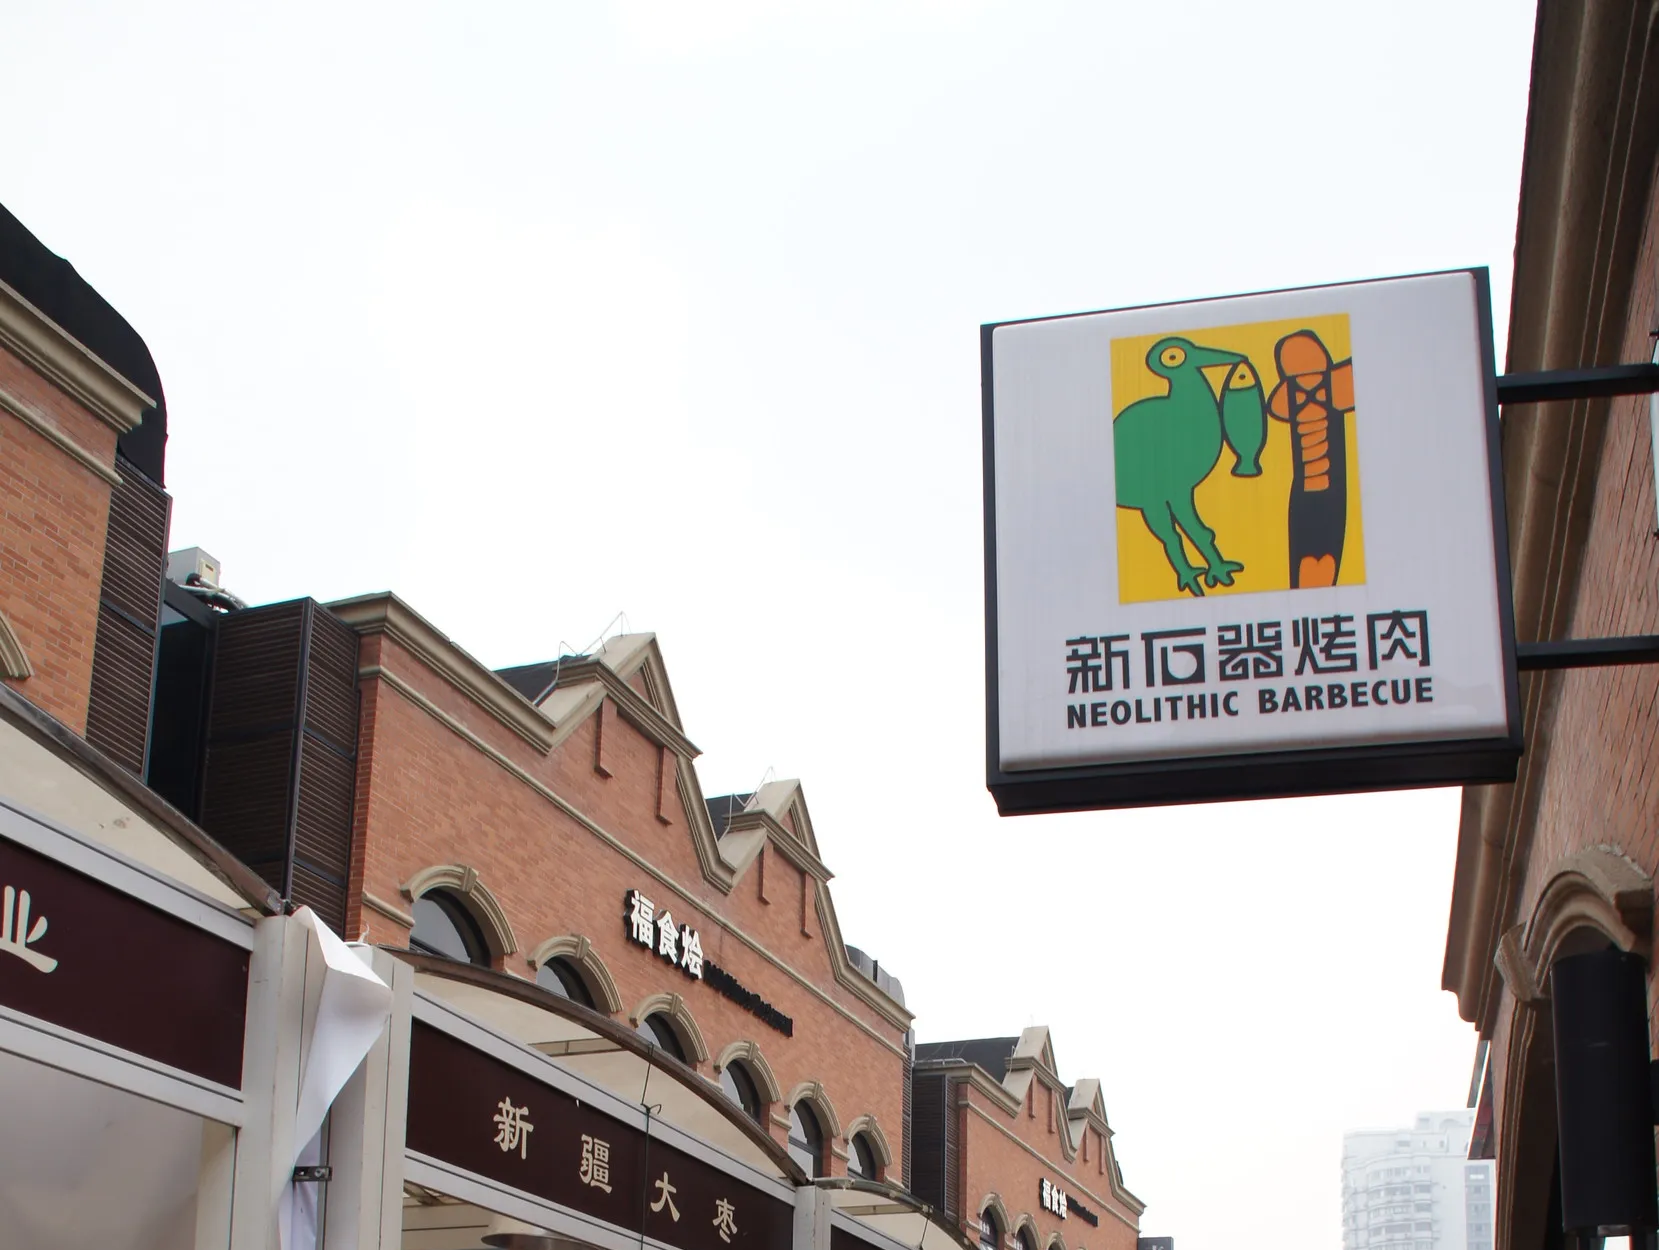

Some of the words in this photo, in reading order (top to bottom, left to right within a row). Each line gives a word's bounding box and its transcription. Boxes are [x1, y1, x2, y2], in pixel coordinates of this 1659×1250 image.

[1066, 610, 1431, 694] 新石器烤肉
[1066, 690, 1240, 729] NEOLITHIC
[1258, 677, 1434, 714] BARBECUE
[630, 889, 704, 980] 福食烩
[493, 1096, 738, 1243] 新疆大枣
